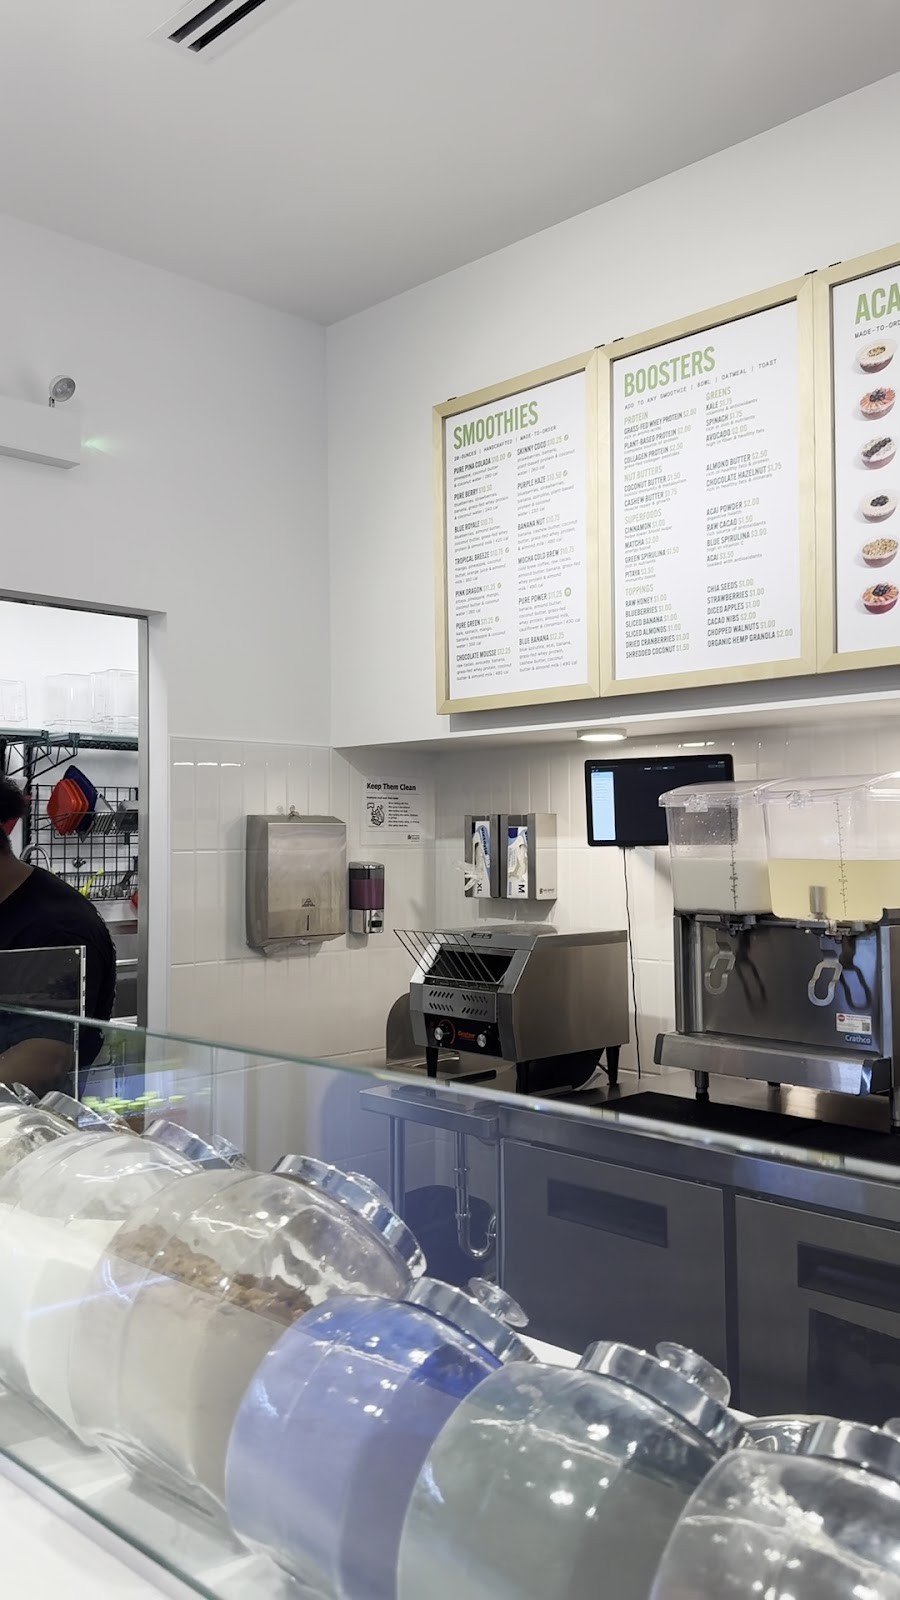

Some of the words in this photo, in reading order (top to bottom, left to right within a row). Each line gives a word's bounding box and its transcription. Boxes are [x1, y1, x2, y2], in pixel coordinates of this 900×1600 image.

[624, 346, 716, 398] BOOSTERS
[660, 386, 687, 399] SMOOTHIE
[697, 379, 710, 388] BOWL
[721, 368, 746, 381] OATMEAL
[759, 359, 777, 370] TOAST
[706, 386, 731, 401] GREENS
[706, 402, 718, 411] KALE
[454, 400, 538, 450] SMOOTHIES
[624, 411, 648, 425] PROTEIN
[624, 422, 648, 435] GRASS-FED
[650, 418, 662, 428] WHEY
[663, 412, 682, 424] PROTEIN
[683, 408, 697, 418] $2.00
[706, 414, 728, 427] SPINACH
[730, 410, 743, 420] $1.75
[484, 439, 512, 452] HANDCRAFTED
[520, 425, 556, 441] MADE-TO-ORDER
[624, 435, 655, 450] PLANT-BASED
[656, 429, 676, 441] PROTEIN
[678, 425, 691, 435] $2.00
[706, 429, 730, 442] AVOCADO
[732, 424, 748, 435] $2.00
[517, 444, 533, 456] SKINNY
[535, 440, 546, 450] COCO
[624, 452, 647, 464] COLLAGEN
[649, 446, 668, 458] PROTEIN
[670, 442, 683, 452] $2.50
[454, 466, 464, 474] PURE
[475, 458, 491, 468] COLADA
[706, 459, 728, 472] ALMOND
[730, 454, 750, 466] BUTTER
[752, 449, 768, 460] $2.50
[624, 472, 636, 482] NUT
[636, 465, 662, 479] BUTTERS
[706, 473, 737, 487] CHOCOLATE
[738, 466, 767, 480] HAZELNUT
[768, 462, 782, 473] $1.75
[518, 479, 533, 490] PURPLE
[535, 476, 546, 485] HAZE
[624, 480, 647, 492] COCONUT
[648, 476, 666, 487] BUTTER
[667, 472, 680, 482] $1.50
[454, 492, 464, 500] PURE
[465, 488, 478, 497] BERRY
[624, 496, 644, 507] CASHEW
[645, 491, 664, 502] BUTTER
[665, 488, 678, 498] $1.75
[707, 506, 719, 516] ACAI
[720, 501, 742, 513] POWDER
[744, 497, 760, 508] $2.00
[624, 508, 662, 524] SUPERFOODS
[707, 522, 718, 531] RAW
[720, 518, 737, 529] CACAO
[738, 514, 753, 525] $1.50
[455, 524, 464, 533] BLUE
[465, 520, 480, 530] ROYALE
[518, 520, 535, 530] BANANA
[536, 518, 545, 526] NUT
[625, 522, 651, 534] CINNAMON
[652, 519, 665, 528] $1.00
[625, 538, 644, 549] MATCHA
[707, 537, 720, 547] BLUE
[721, 531, 750, 544] SPIRULINA
[455, 555, 474, 565] TROPICAL
[475, 551, 489, 560] BREEZE
[518, 555, 533, 564] MOCHA
[534, 552, 545, 561] COLD
[546, 549, 559, 558] BREW
[625, 554, 640, 563] GREEN
[641, 549, 666, 560] SPIRULINA
[666, 546, 679, 555] $1.50
[707, 554, 718, 562] ACAI
[625, 569, 640, 578] PITAYA
[466, 586, 482, 595] DRAGON
[625, 584, 654, 596] TOPPINGS
[707, 584, 720, 593] CHIA
[721, 581, 738, 591] SEEDS
[739, 578, 754, 588] $1.00
[519, 596, 530, 605] PURE
[531, 593, 547, 603] POWER
[625, 599, 635, 607] RAW
[637, 596, 653, 605] HONEY
[654, 594, 667, 602] $1.00
[707, 590, 748, 604] STRAWBERRIES
[750, 588, 764, 597] $1.00
[626, 606, 657, 618] BLUEBERRIES
[659, 604, 672, 612] $1.00
[707, 605, 723, 615] DICED
[724, 602, 744, 612] APPLES
[745, 600, 760, 609] $1.00
[467, 619, 480, 628] GREEN
[625, 619, 642, 628] SLICED
[643, 616, 663, 625] BANANA
[664, 613, 677, 622] $1.00
[708, 616, 725, 626] CACAO
[726, 614, 739, 623] NIBS
[740, 612, 756, 621] $2.00
[626, 629, 642, 638] SLICED
[643, 626, 666, 636] ALMONDS
[668, 623, 681, 632] $1.00
[708, 626, 732, 637] CHOPPED
[733, 622, 759, 633] WALNUTS
[760, 620, 776, 629] $1.00
[519, 637, 530, 646] BLUE
[531, 634, 549, 644] BANANA
[626, 640, 640, 648] DRIED
[641, 635, 675, 646] CRANBERRIES
[676, 633, 689, 641] $1.00
[708, 637, 731, 648] ORGANIC
[733, 635, 749, 644] HEMP
[750, 631, 775, 642] GRANOLA
[777, 629, 793, 638] $2.00
[457, 652, 479, 662] CHOCOLATE
[480, 649, 496, 658] MOUSSE
[626, 649, 651, 659] SHREDDED
[652, 646, 675, 655] COCONUT
[676, 644, 690, 652] $1.50
[366, 783, 381, 791] Keep
[477, 883, 482, 894] XL
[518, 884, 525, 893] M
[845, 1034, 871, 1044] Crathco
